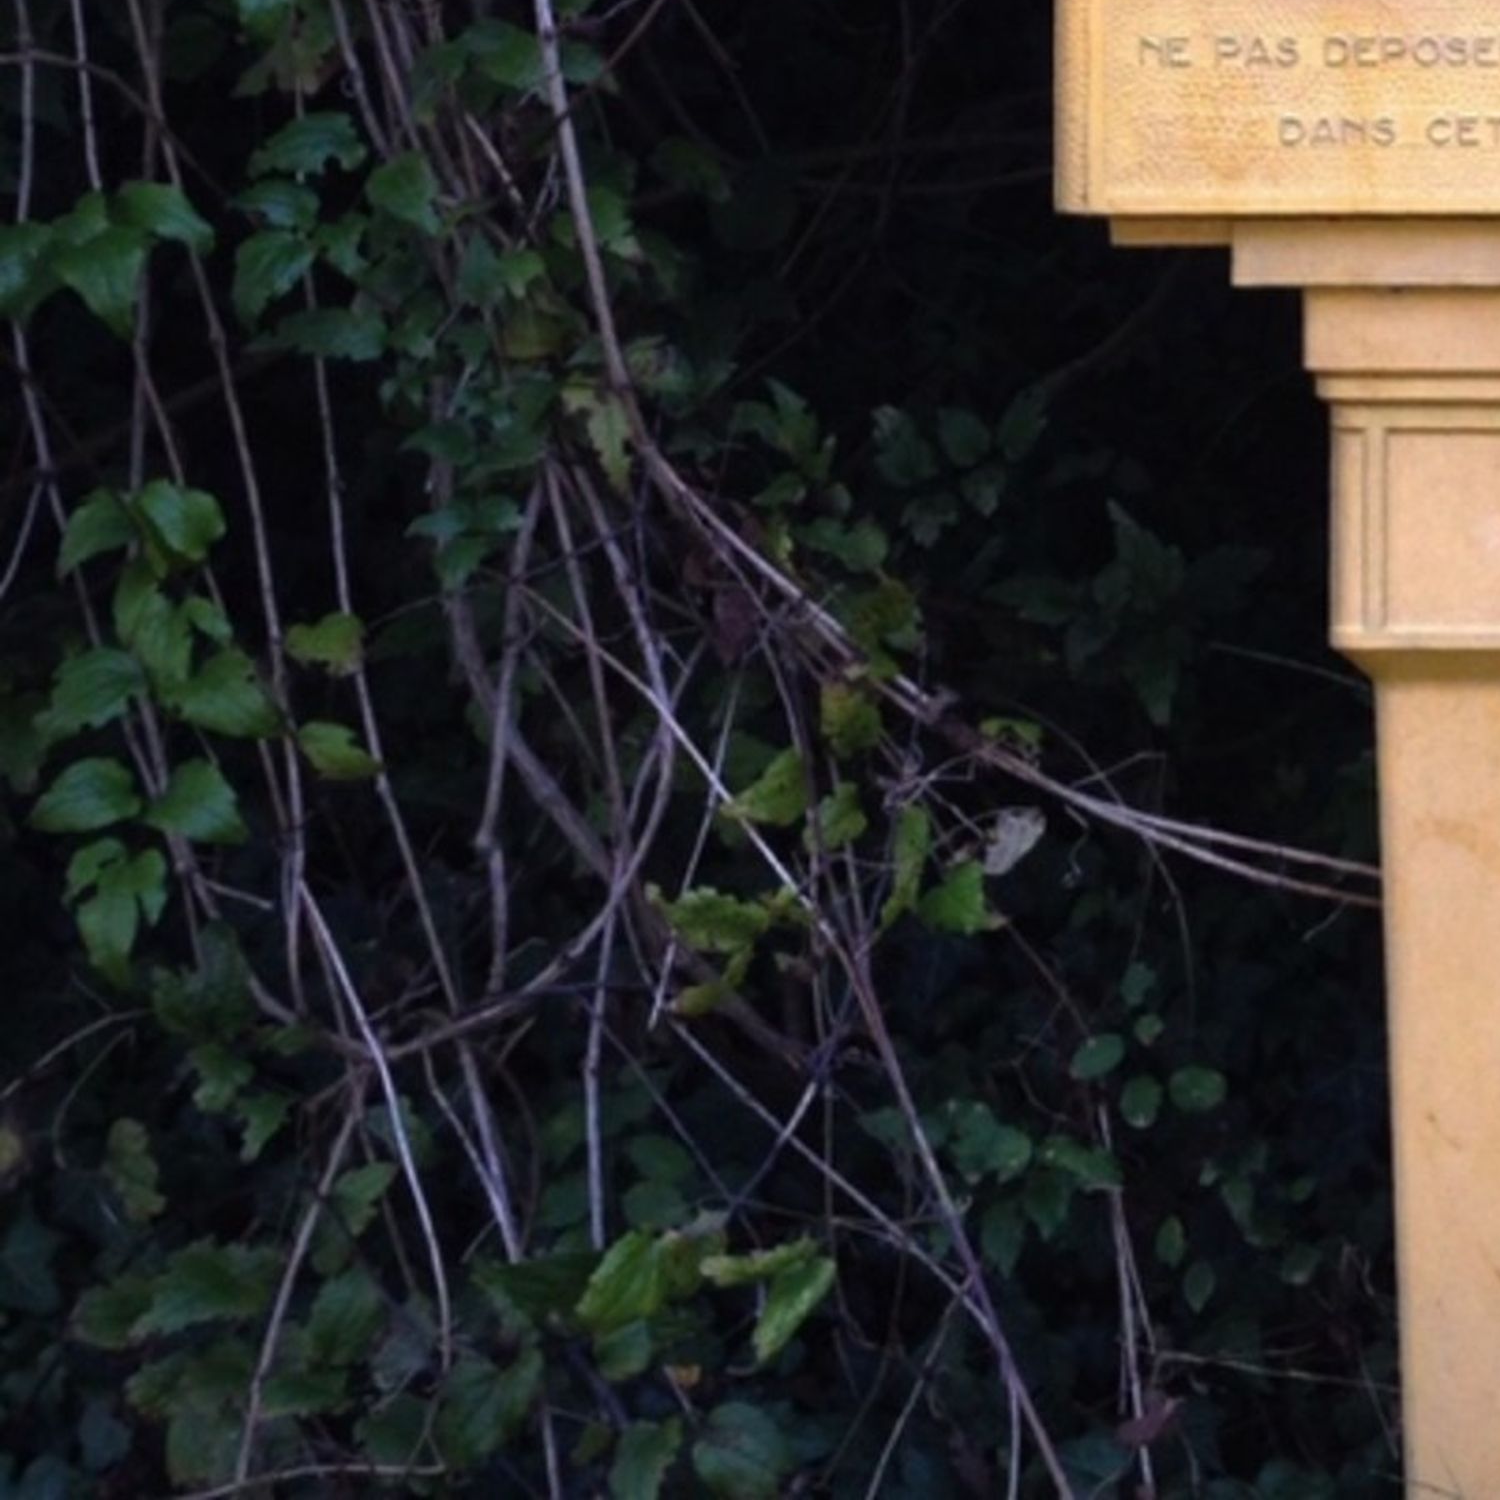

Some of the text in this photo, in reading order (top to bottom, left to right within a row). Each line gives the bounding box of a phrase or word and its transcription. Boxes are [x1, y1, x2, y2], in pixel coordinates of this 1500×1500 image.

[1138, 36, 1192, 69] NE
[1214, 36, 1299, 69] PAS
[1278, 116, 1397, 148] DANS
